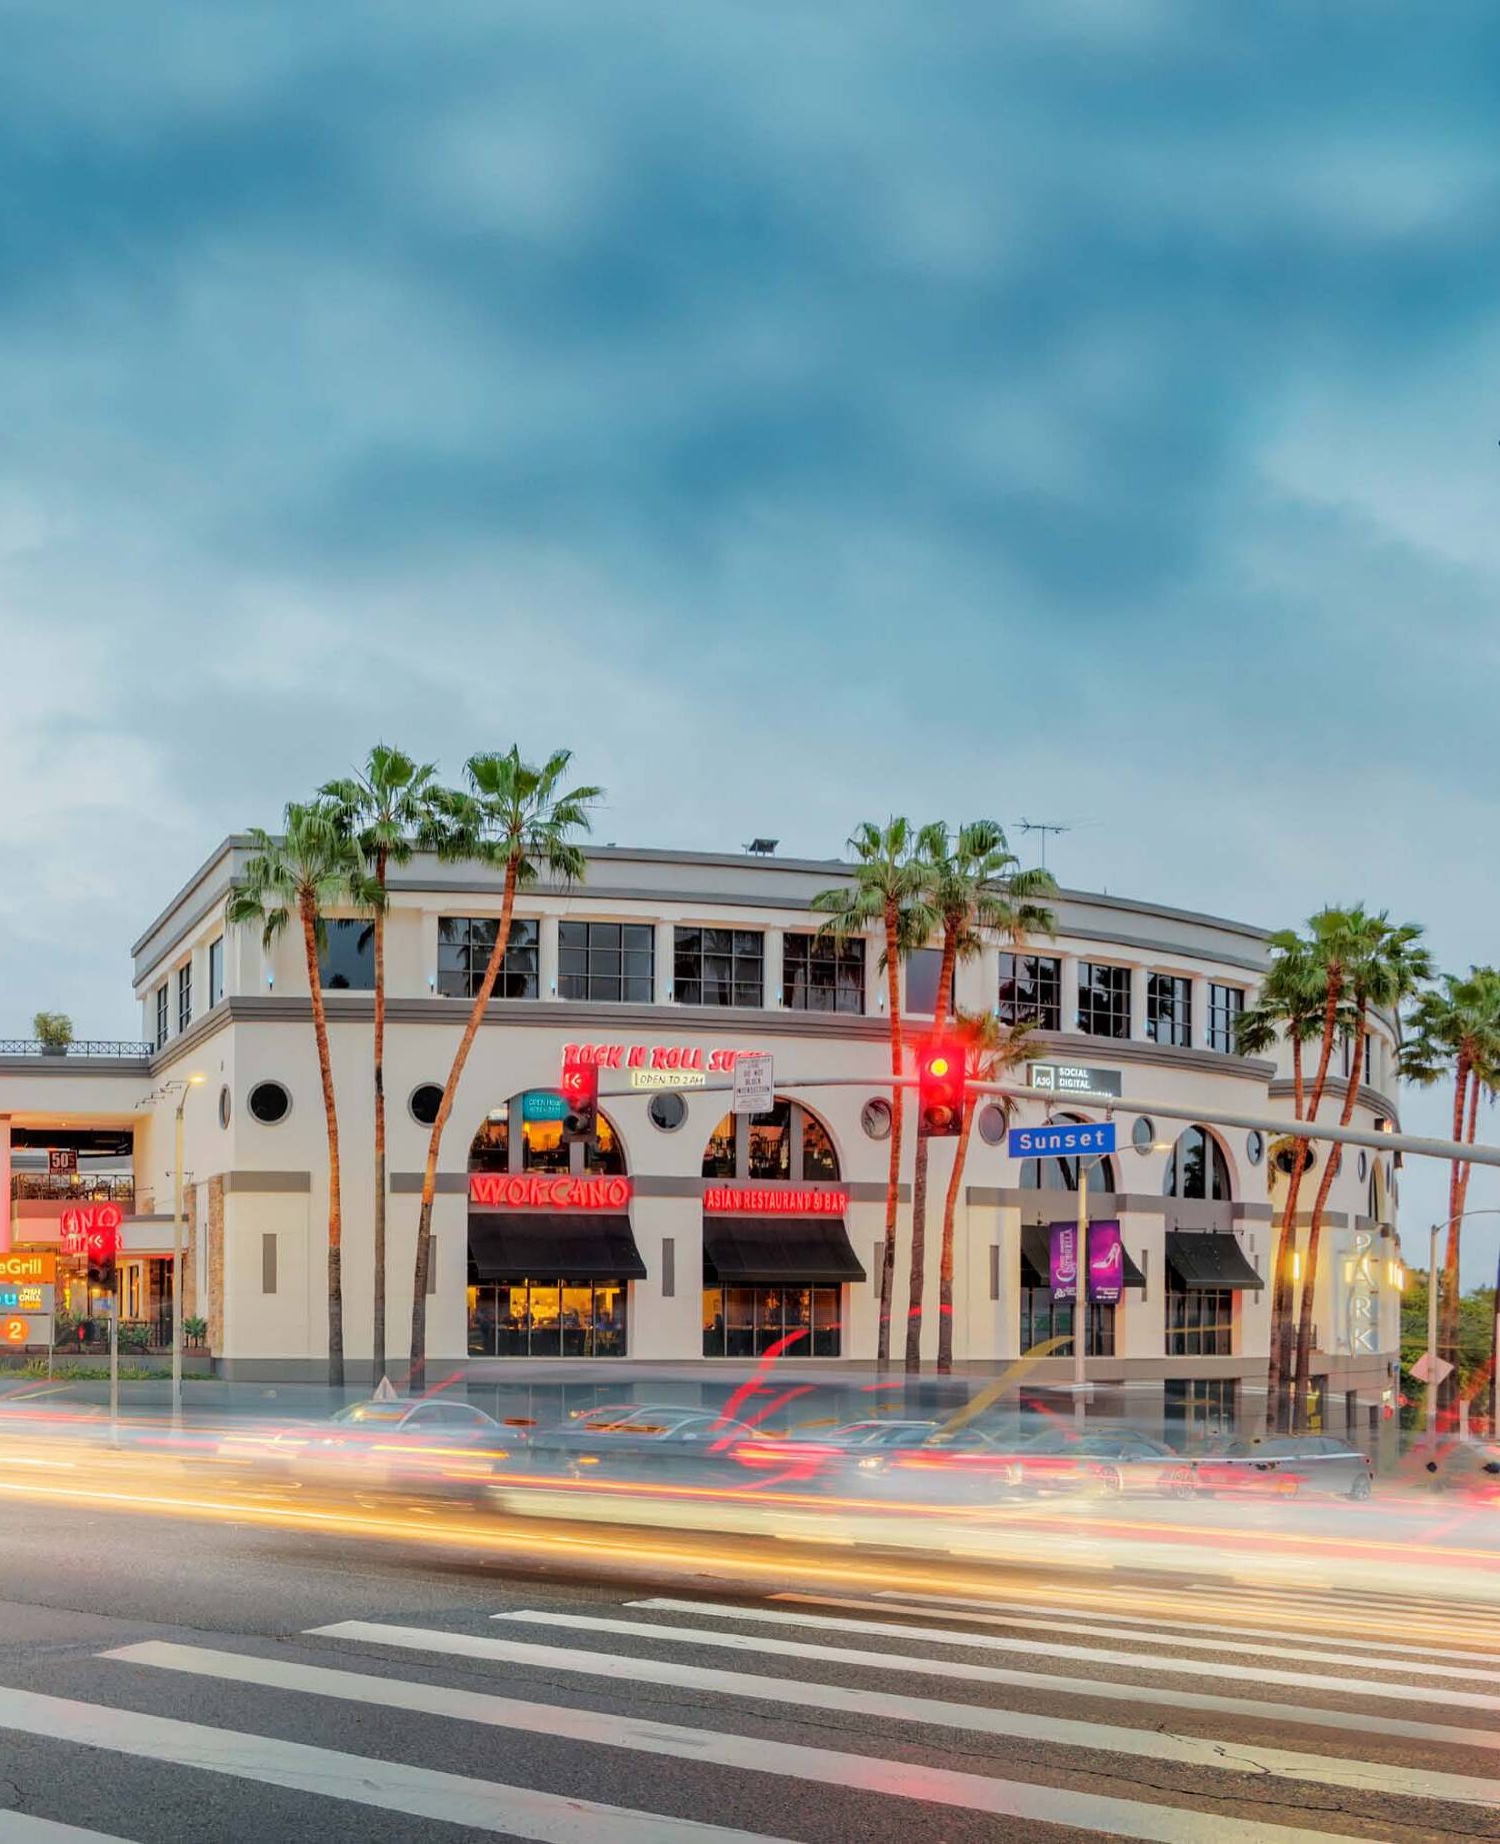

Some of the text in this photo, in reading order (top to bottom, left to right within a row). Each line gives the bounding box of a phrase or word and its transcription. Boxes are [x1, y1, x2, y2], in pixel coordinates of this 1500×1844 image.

[563, 1044, 624, 1068] ROCK
[627, 1045, 648, 1069] N
[651, 1045, 704, 1070] ROLL
[640, 1075, 666, 1084] OPEN
[670, 1076, 680, 1084] TO
[1059, 1067, 1088, 1078] SOCIAL
[1059, 1078, 1091, 1089] DIGITAL
[1019, 1130, 1105, 1150] Sunset
[470, 1177, 629, 1207] WOKCANO
[707, 1190, 741, 1209] ASIAN
[744, 1191, 810, 1210] RESTAURANT
[825, 1193, 846, 1212] BAR
[1355, 1233, 1376, 1352] PARK
